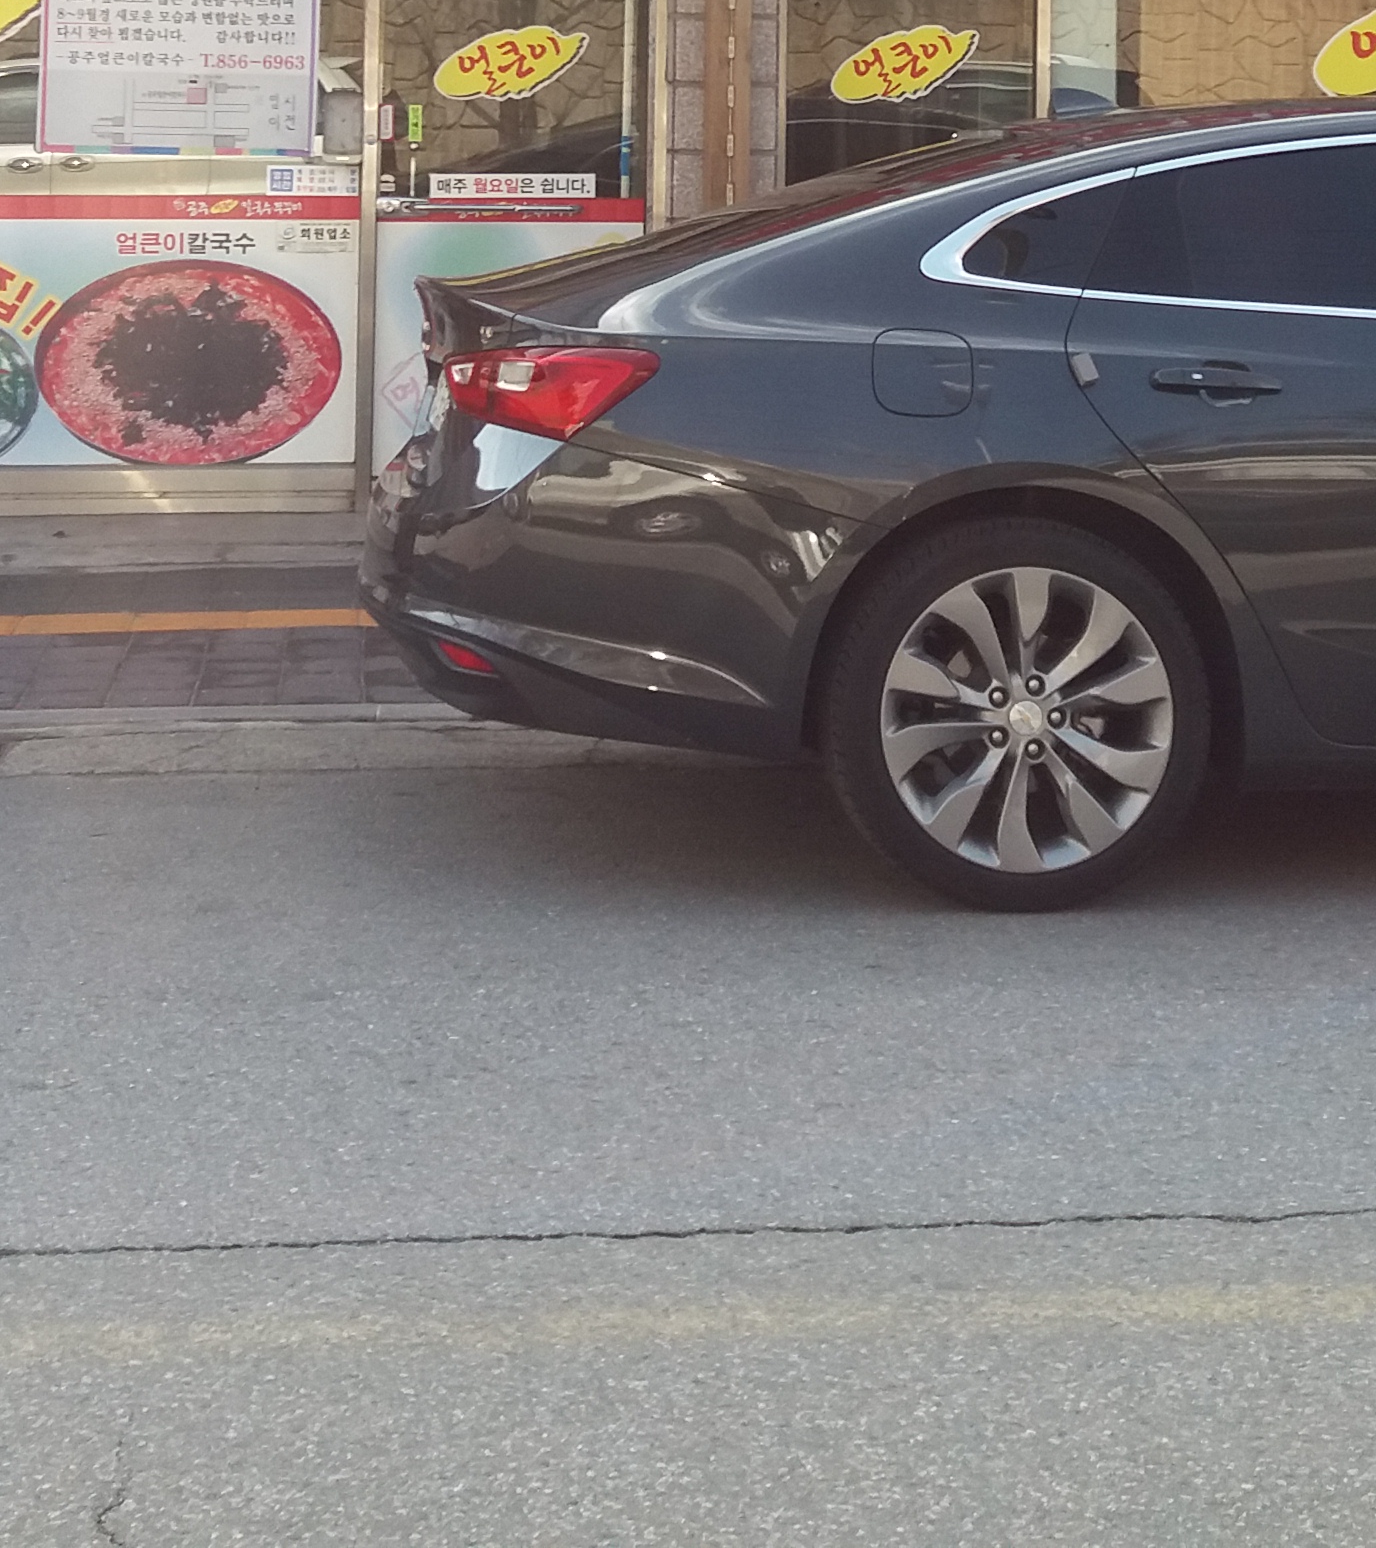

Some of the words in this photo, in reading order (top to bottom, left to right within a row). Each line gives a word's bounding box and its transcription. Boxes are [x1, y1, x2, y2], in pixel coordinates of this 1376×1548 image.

[57, 25, 82, 39] 다시
[458, 36, 561, 95] 얼큰이
[853, 35, 953, 97] 얼큰이
[437, 178, 468, 194] 매주
[474, 177, 536, 194] 월요일은
[540, 178, 591, 194] 쉽니다.
